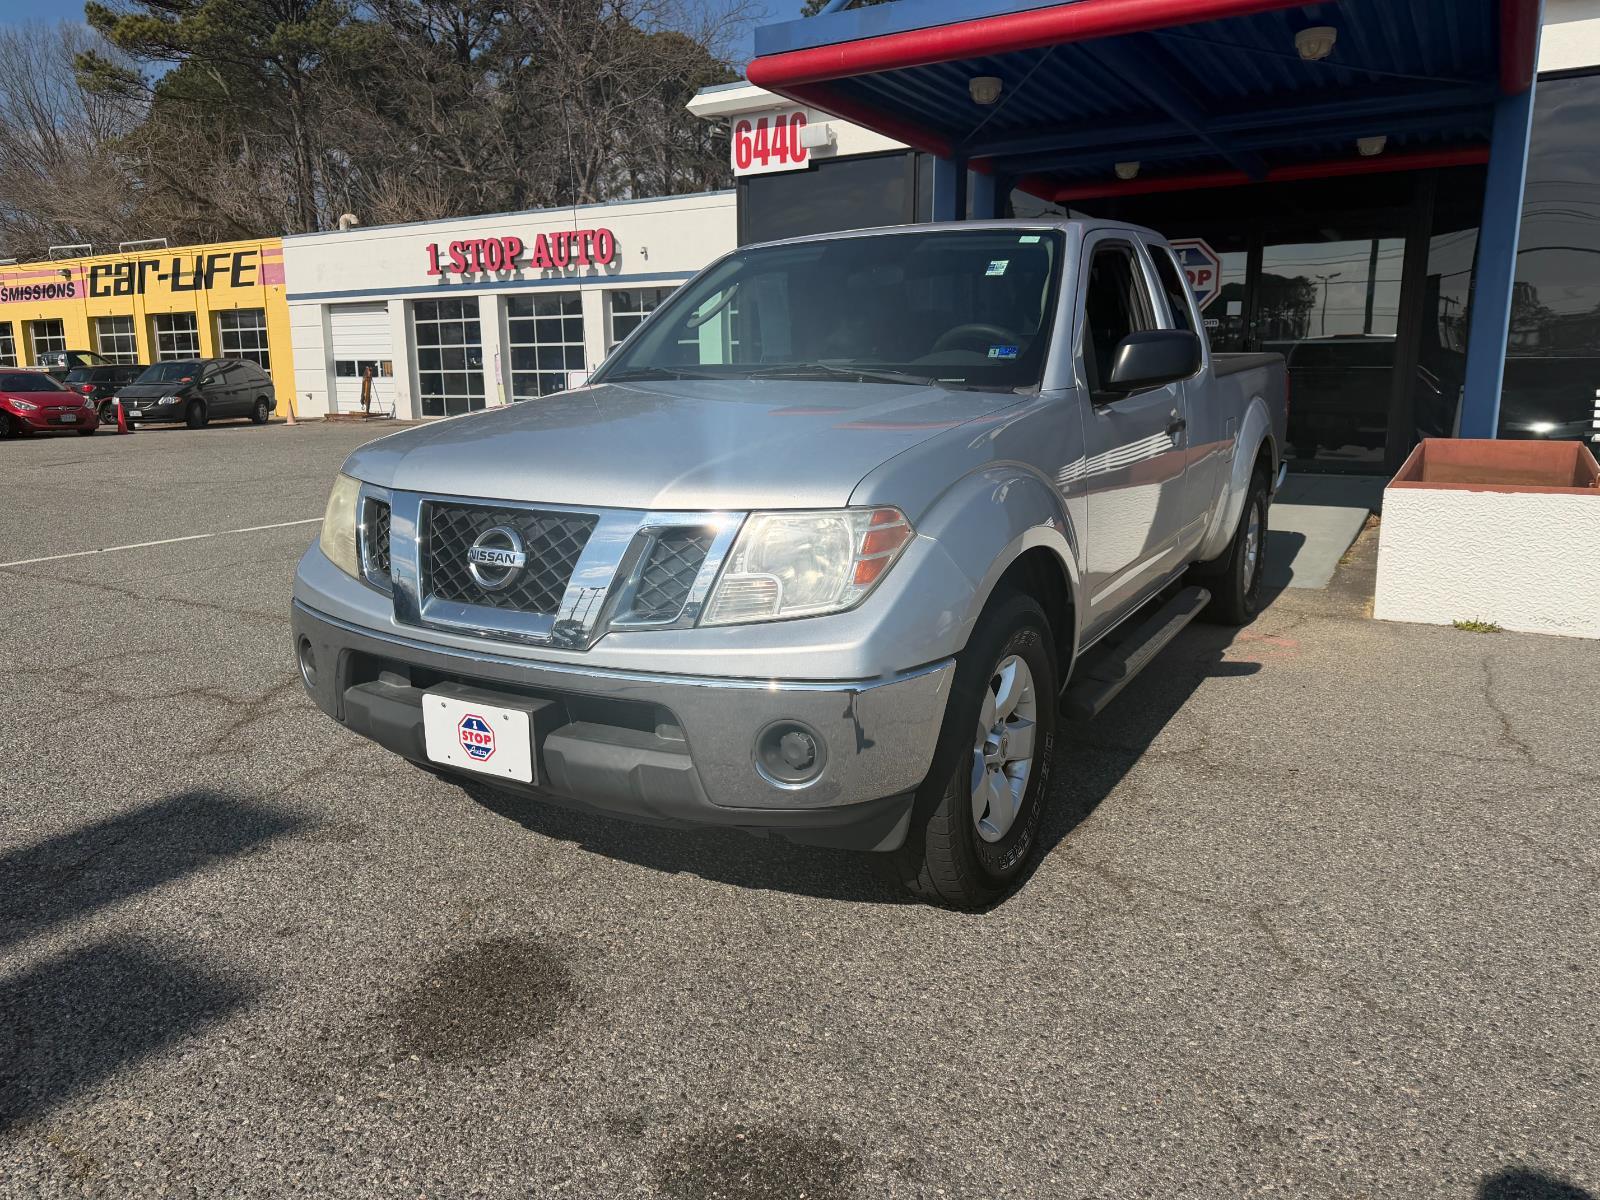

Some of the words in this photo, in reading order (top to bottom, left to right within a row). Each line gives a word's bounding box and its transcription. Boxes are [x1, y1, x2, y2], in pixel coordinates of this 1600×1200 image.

[735, 112, 807, 169] 6440
[426, 243, 442, 275] 1
[449, 237, 522, 273] STOP
[530, 228, 615, 268] AUTO
[0, 282, 76, 301] SMISSIONS
[469, 549, 516, 564] NISSAN
[472, 720, 478, 730] 1
[462, 730, 491, 745] STOP
